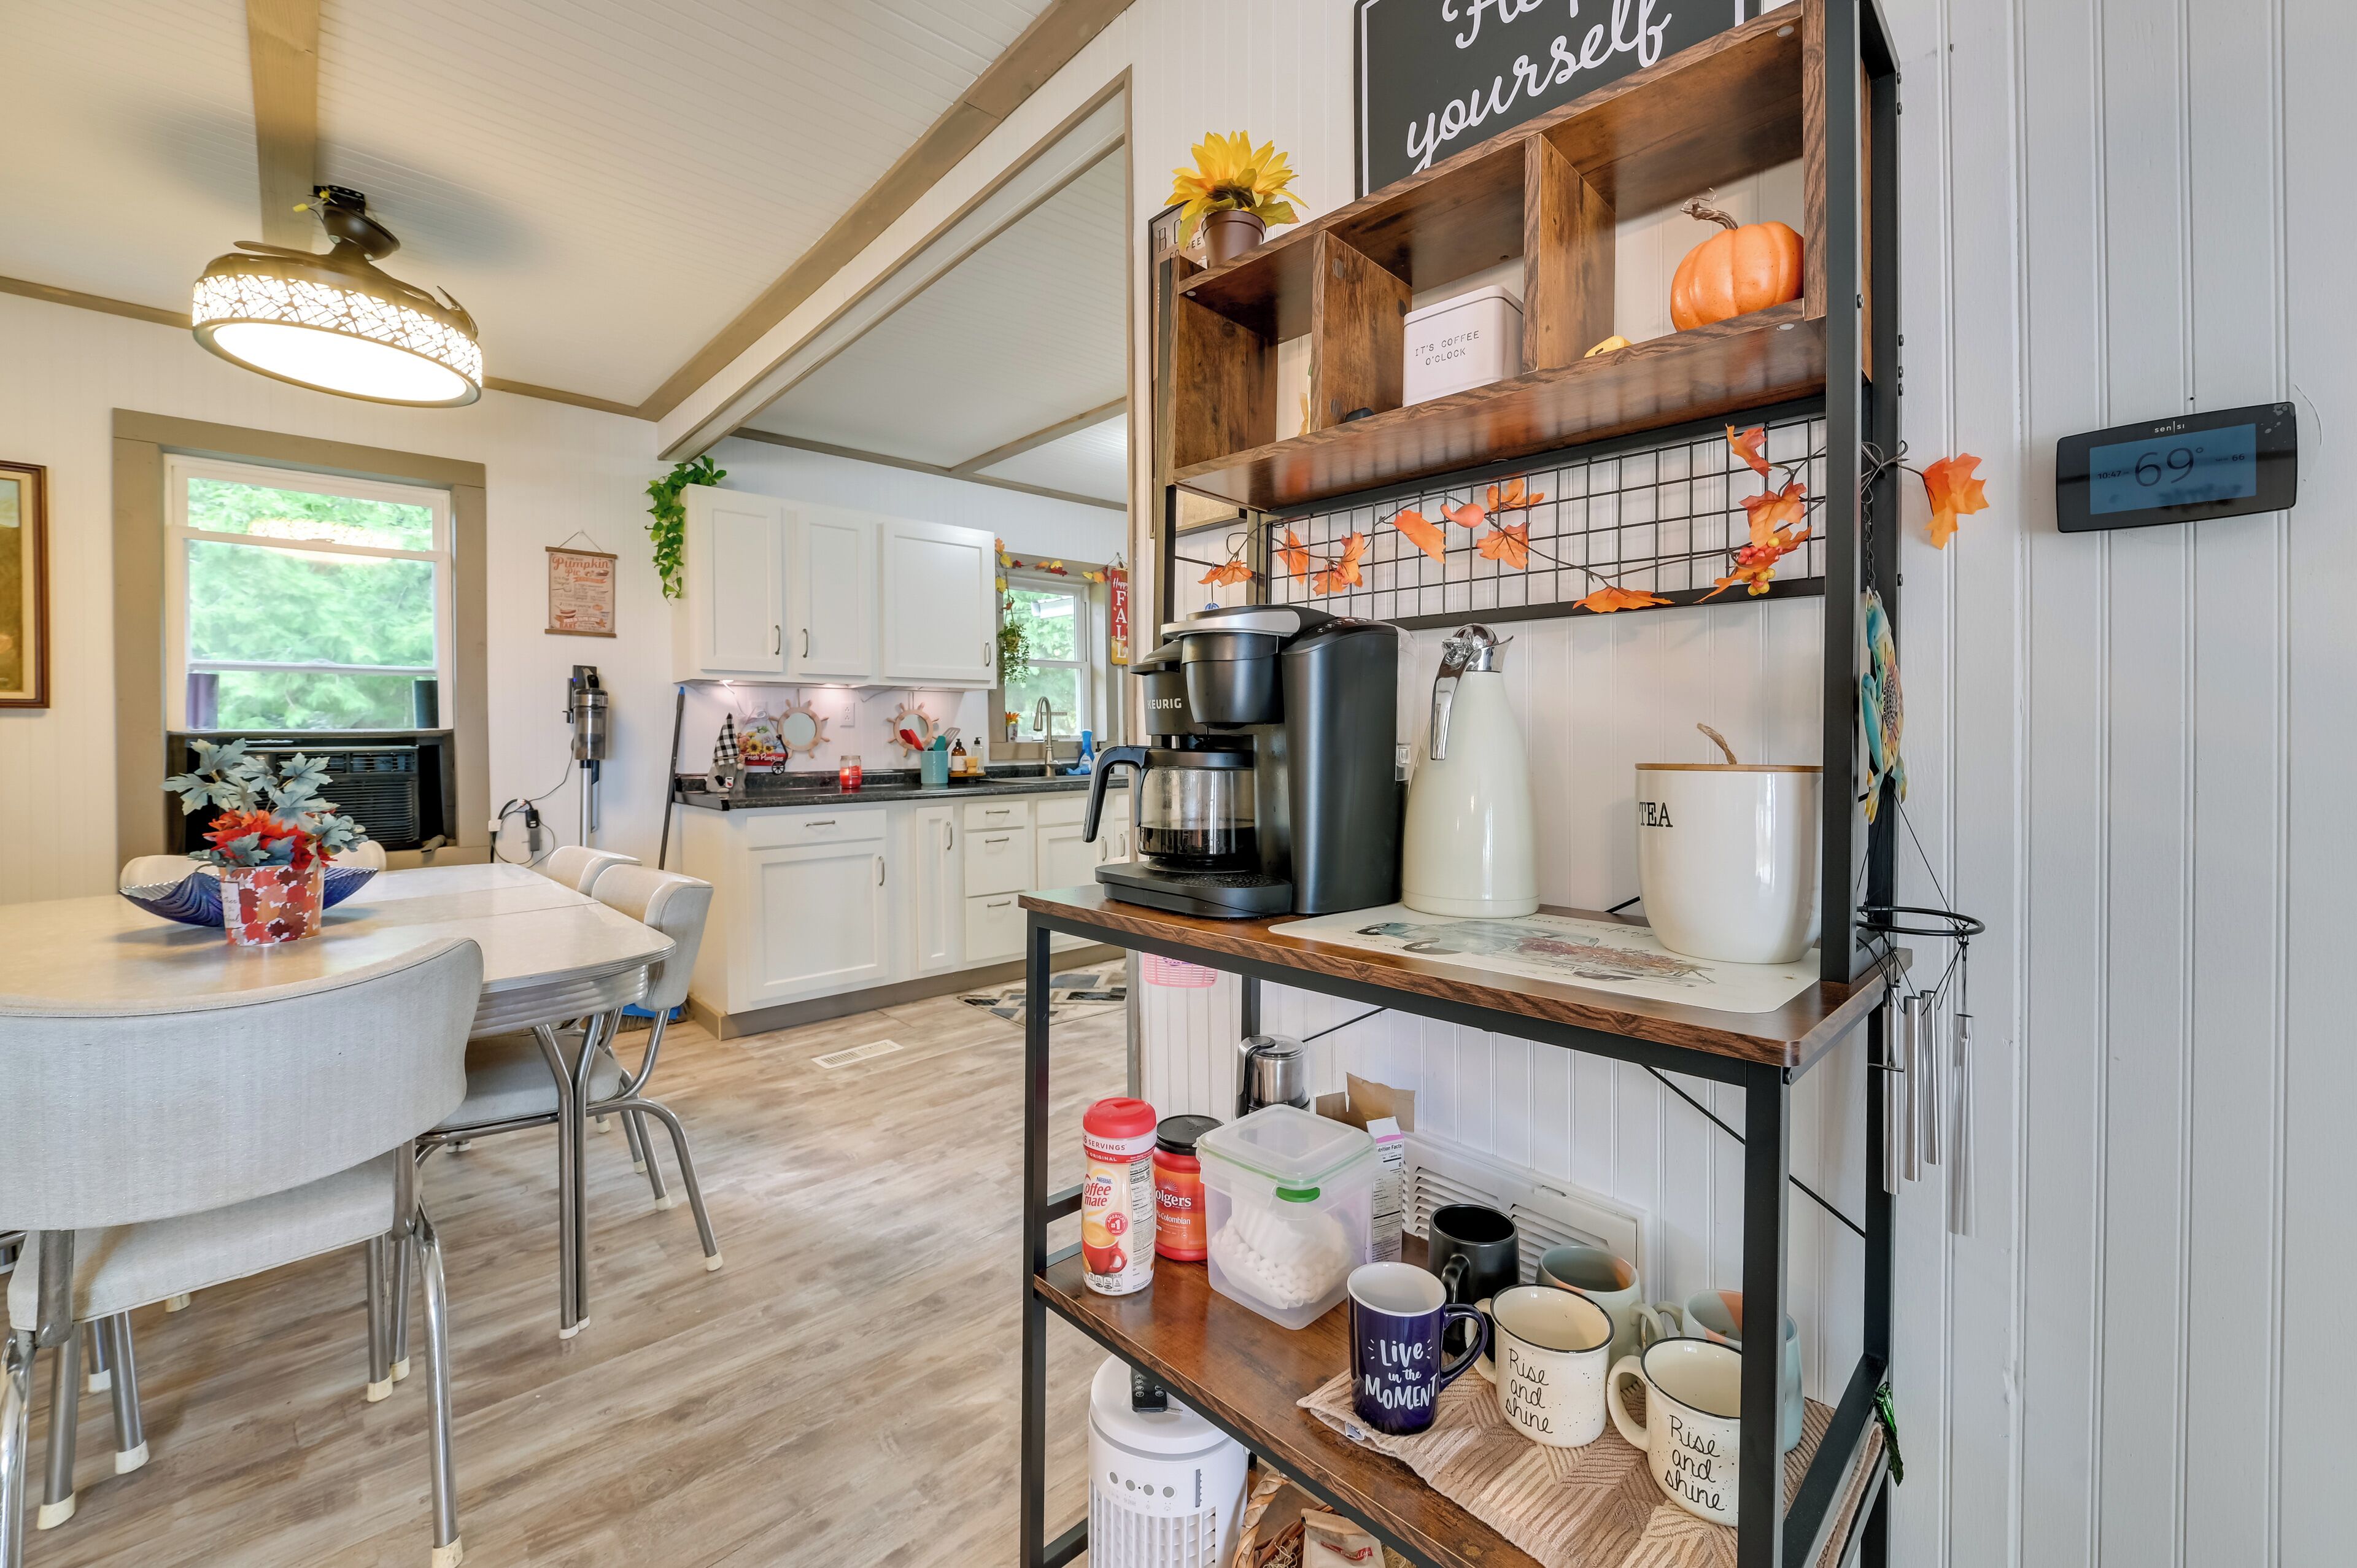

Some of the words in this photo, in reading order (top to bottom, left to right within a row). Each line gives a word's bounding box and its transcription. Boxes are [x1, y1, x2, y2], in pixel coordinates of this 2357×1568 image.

[1407, 0, 1672, 175] yourself
[1415, 344, 1434, 357] IT'S
[1441, 330, 1480, 348] COFFEE
[1425, 347, 1466, 366] O'CLOCK
[2097, 470, 2122, 479] 10:47
[2232, 453, 2245, 462] 66
[552, 556, 610, 570] Pumpkin
[1115, 590, 1128, 658] FALL
[1147, 698, 1182, 709] KEURIG
[1639, 801, 1673, 828] TEA
[1085, 1195, 1107, 1207] mate
[1156, 1189, 1191, 1207] olgers
[1111, 1219, 1121, 1230] #1
[1388, 1372, 1401, 1383] in
[1402, 1369, 1422, 1380] the
[1509, 1348, 1549, 1386] Rise
[1511, 1379, 1546, 1408] and
[1506, 1397, 1554, 1434] shine
[1669, 1414, 1720, 1458] Rise
[1672, 1449, 1716, 1483] and
[1665, 1469, 1725, 1511] shine
